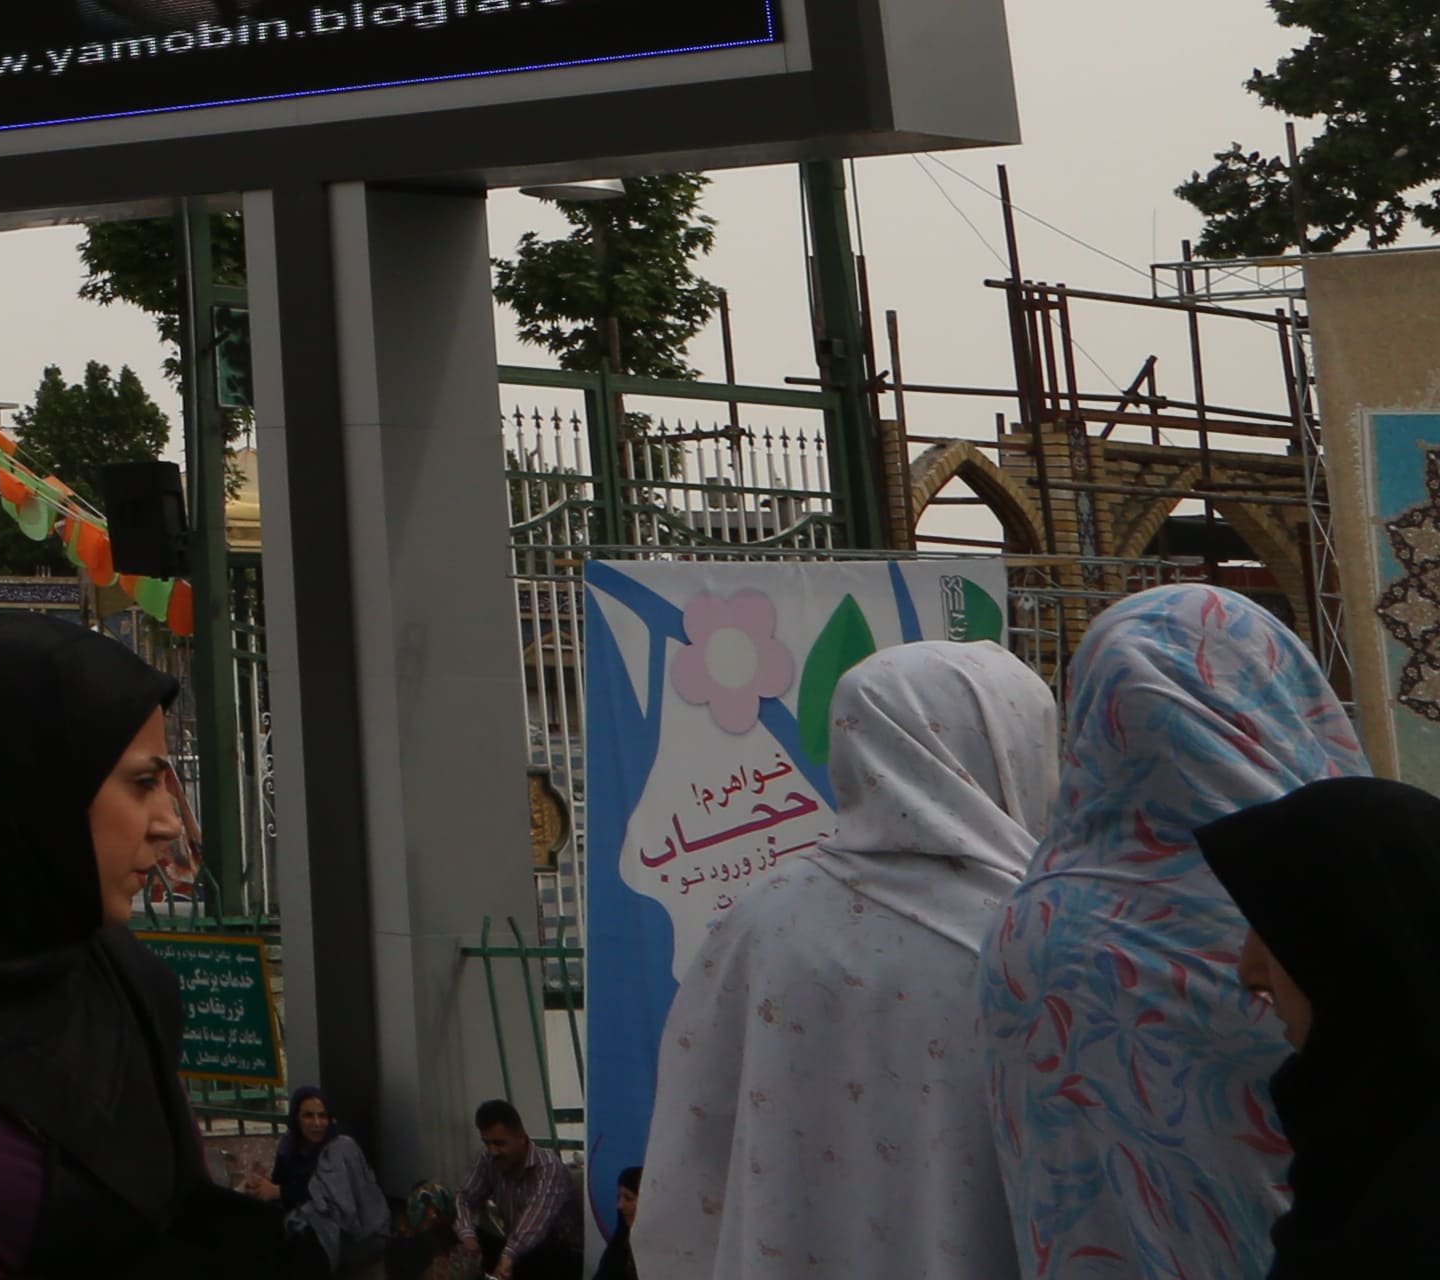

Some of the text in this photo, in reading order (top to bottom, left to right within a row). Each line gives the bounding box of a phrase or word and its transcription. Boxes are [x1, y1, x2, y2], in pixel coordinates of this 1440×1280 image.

[691, 753, 792, 815] خواهرم!
[639, 792, 819, 883] حجاب
[680, 865, 705, 894] تو
[710, 854, 753, 882] ورود
[186, 968, 219, 992] پزشکی
[219, 970, 255, 989] خدمات
[197, 997, 245, 1022] تزریقات
